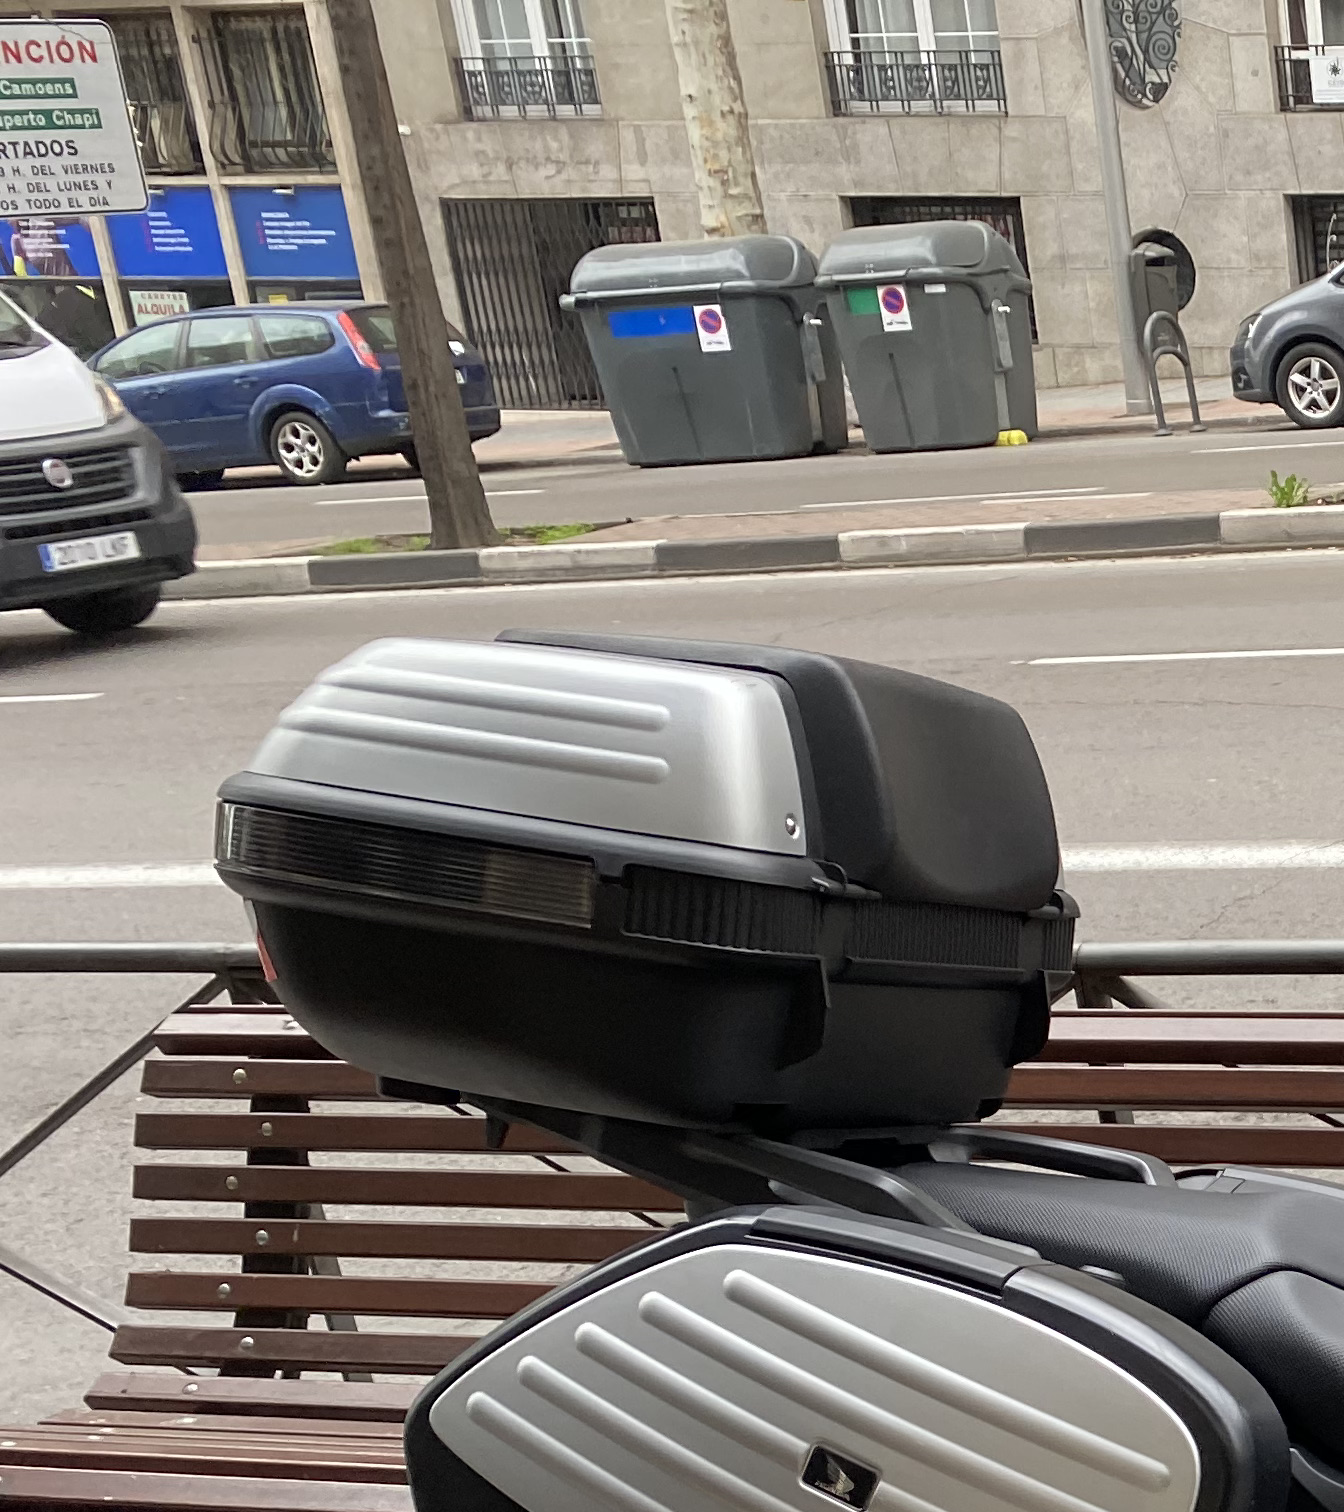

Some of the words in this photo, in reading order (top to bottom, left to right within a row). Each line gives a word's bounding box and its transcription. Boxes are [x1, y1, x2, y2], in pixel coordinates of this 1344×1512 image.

[0, 35, 98, 64] NCIÓN
[0, 80, 73, 95] Camoens
[31, 164, 55, 176] DEL
[61, 162, 115, 175] VIERNES
[27, 181, 51, 193] DEL
[57, 180, 99, 192] LUNES
[26, 198, 60, 209] TODO
[67, 197, 83, 208] EL
[137, 303, 186, 315] ALQUILA
